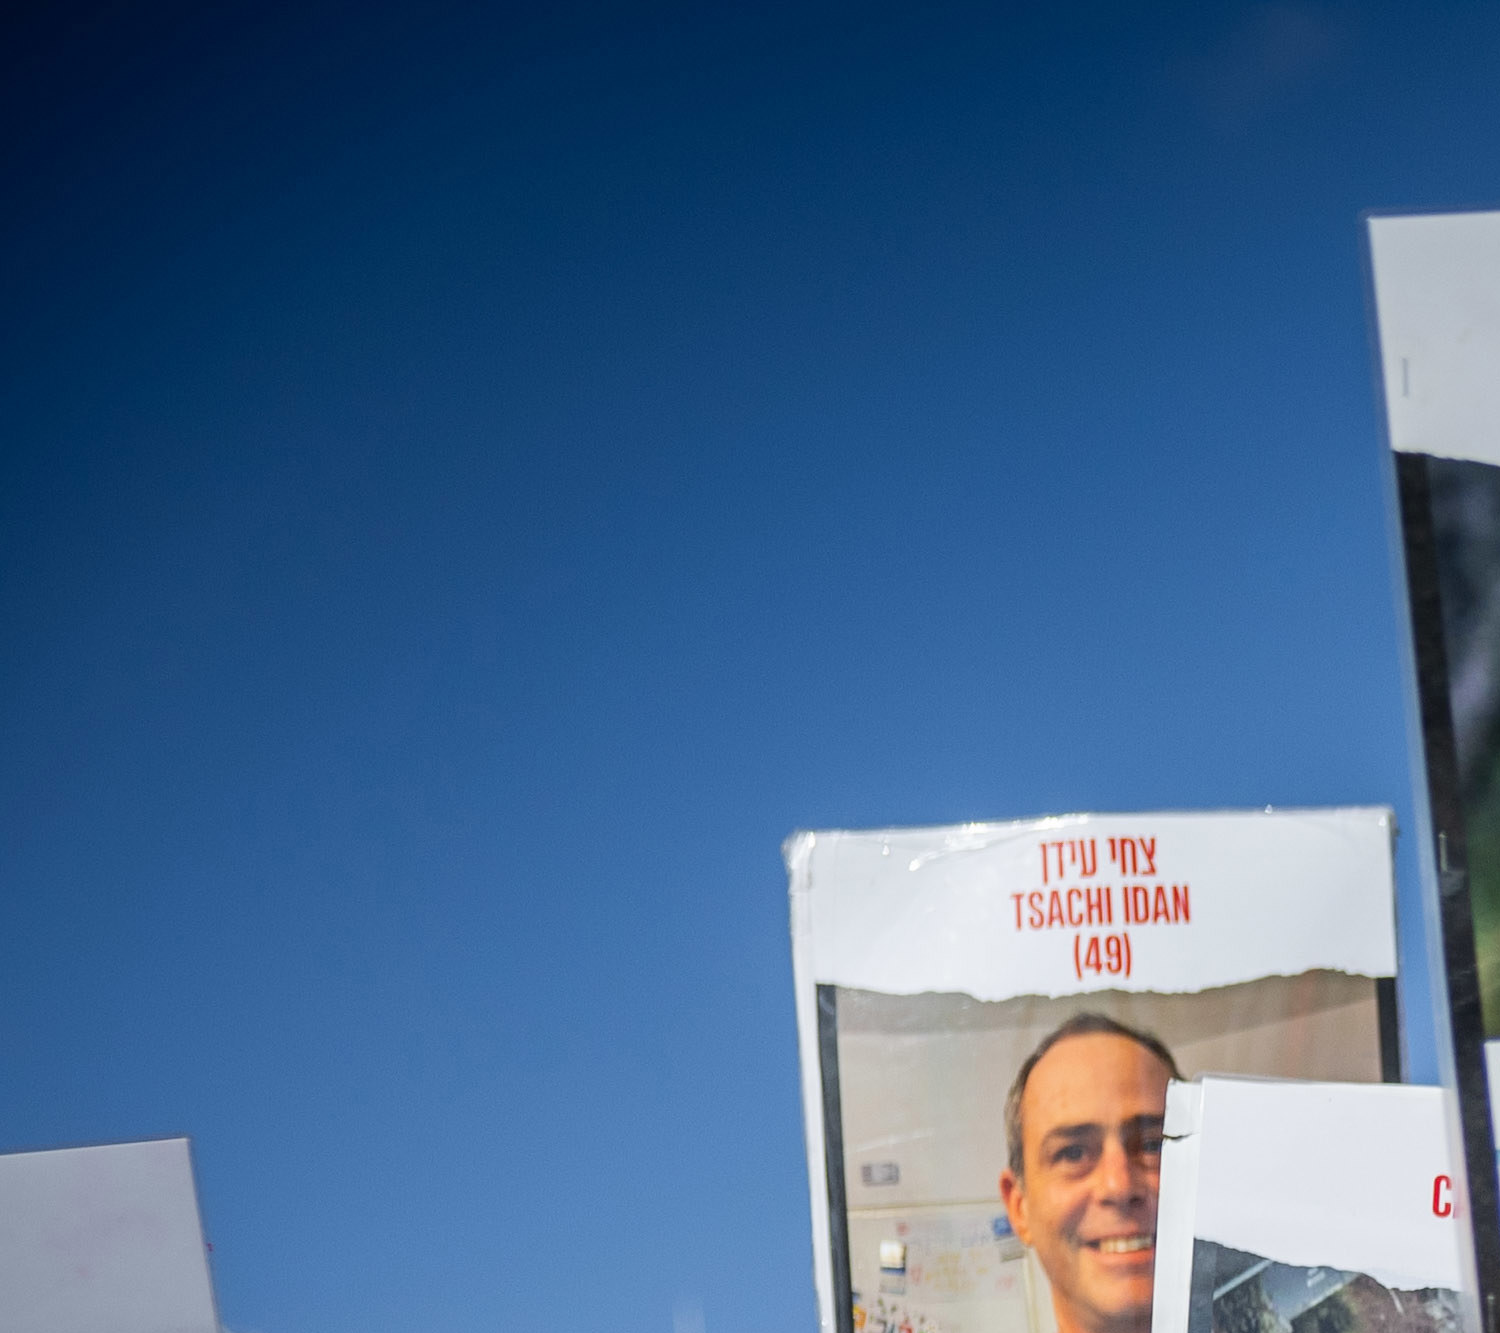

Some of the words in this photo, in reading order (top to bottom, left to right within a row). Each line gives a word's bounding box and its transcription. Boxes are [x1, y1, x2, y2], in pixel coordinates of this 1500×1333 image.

[1038, 840, 1098, 885] עידן
[1108, 836, 1158, 877] צחי
[1010, 886, 1112, 931] TSACHI
[1123, 884, 1191, 926] IDAN
[1074, 932, 1133, 980] (49)
